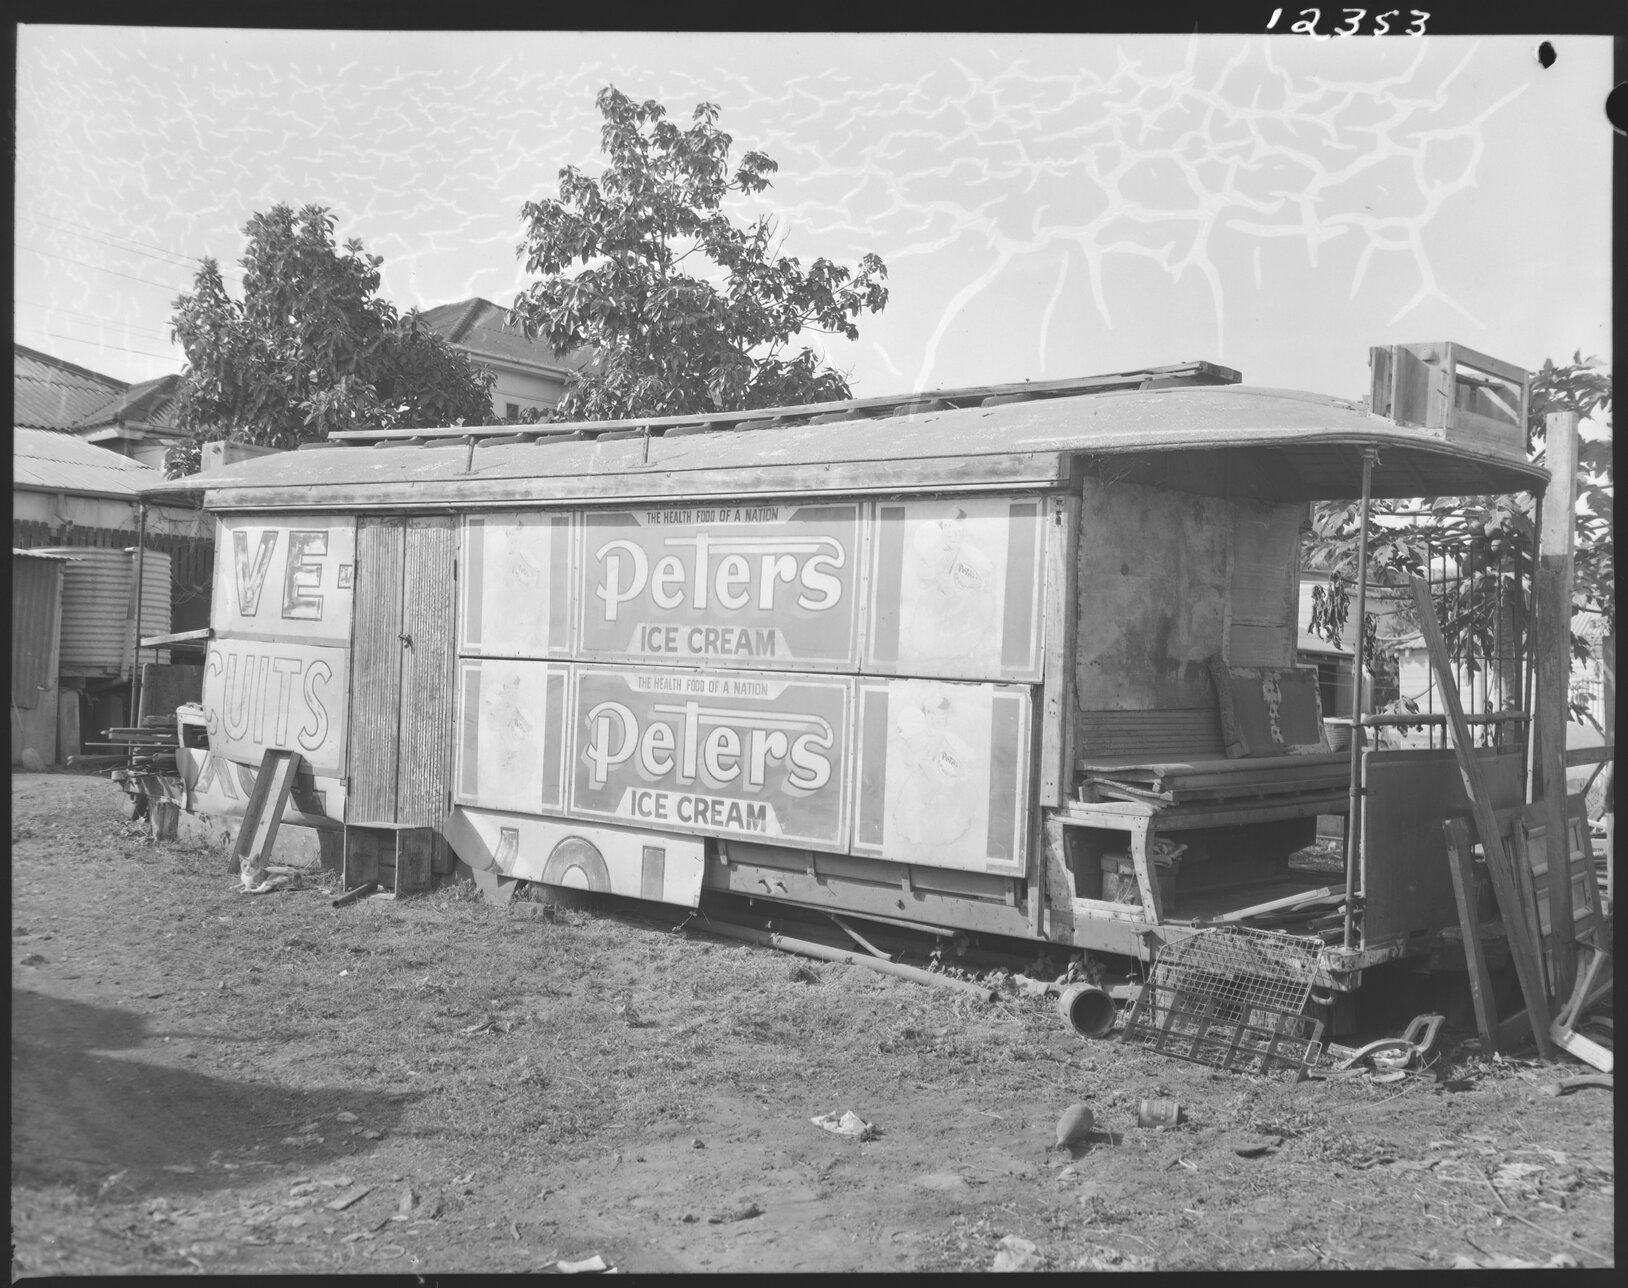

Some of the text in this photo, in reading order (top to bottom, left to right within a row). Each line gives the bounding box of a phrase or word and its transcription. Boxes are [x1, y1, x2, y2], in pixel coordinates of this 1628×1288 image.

[647, 507, 779, 524] THE HEALTH FOOD OF A NATION
[594, 531, 846, 622] Peters
[640, 626, 776, 657] ICE CREAM
[638, 676, 769, 696] THE HEALTH FOOD OF A NATION
[585, 701, 835, 792] Peters
[631, 790, 767, 832] ICE CREAM
